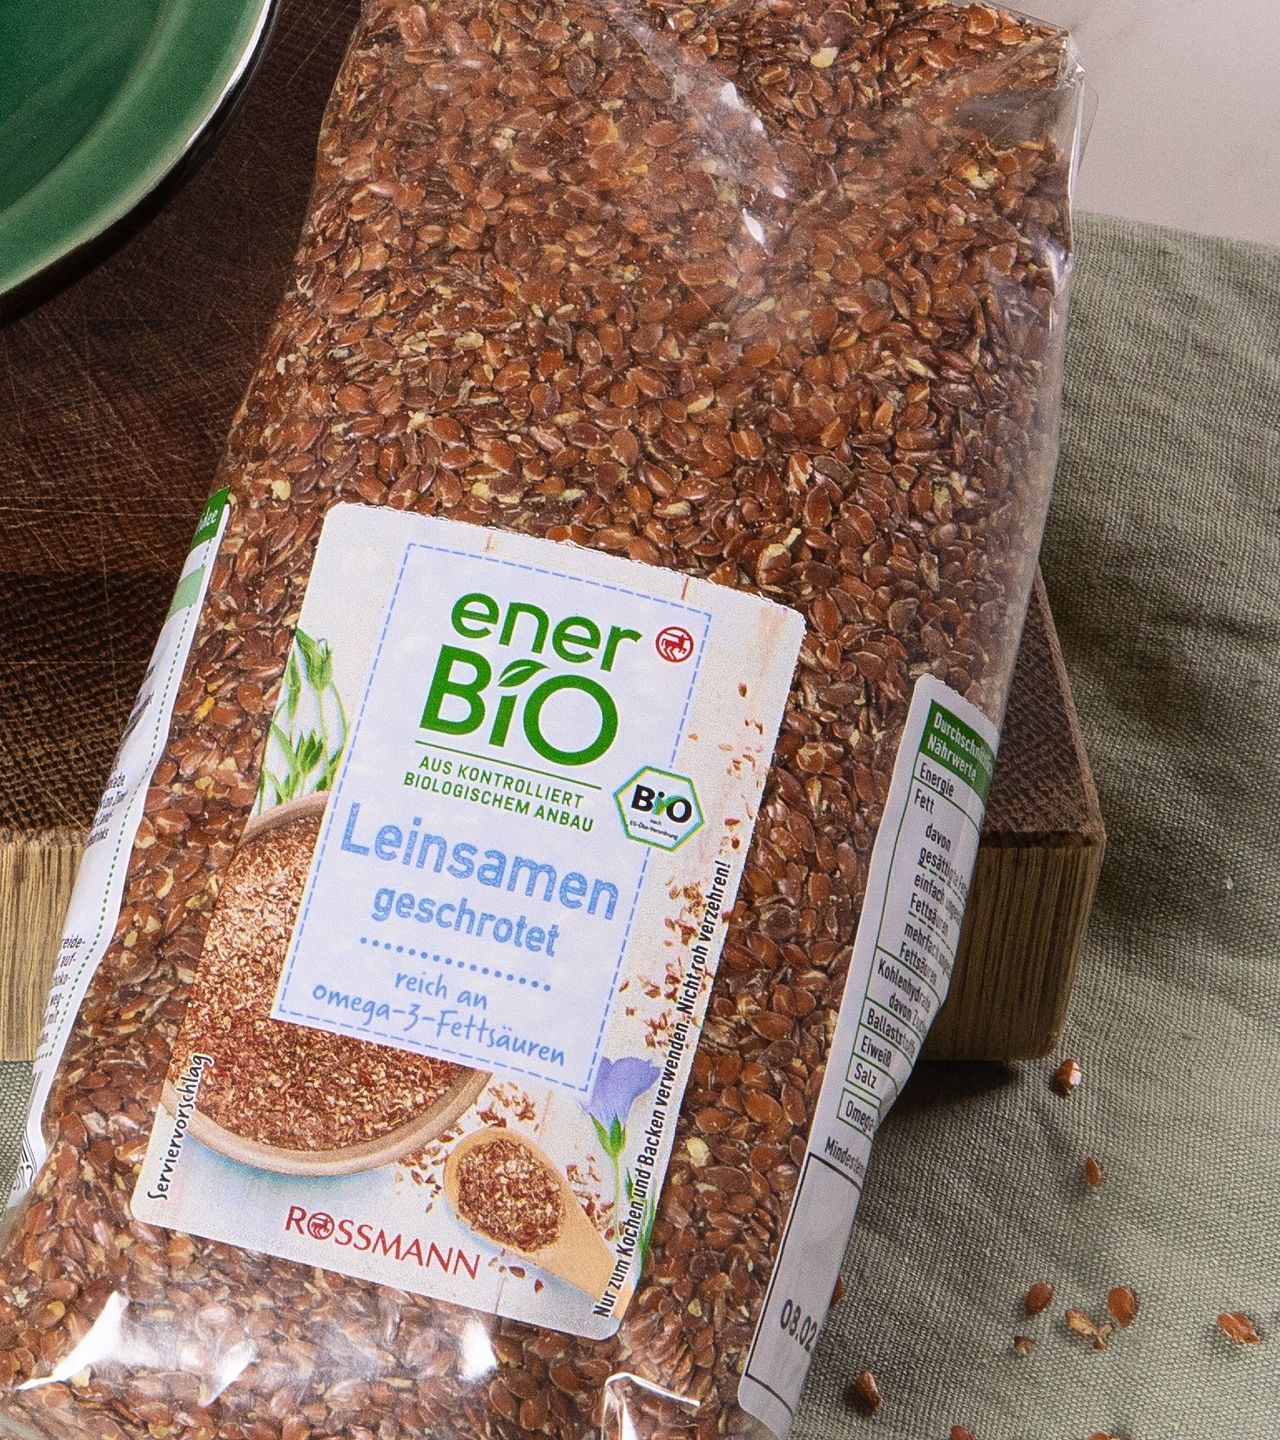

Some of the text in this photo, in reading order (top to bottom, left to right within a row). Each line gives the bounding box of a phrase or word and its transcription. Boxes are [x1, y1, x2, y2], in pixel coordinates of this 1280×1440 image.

[450, 592, 643, 672] ener
[418, 755, 585, 809] AUS KONTROLLIERT
[920, 762, 954, 799] Energie
[927, 733, 977, 781] Nährwerte
[403, 771, 595, 833] BIOLOGISCHEM ANBAU
[914, 788, 935, 815] Fett
[339, 802, 620, 921] Leinsamen
[925, 822, 952, 852] davon
[371, 886, 560, 958] geschrotet
[395, 971, 488, 1010] reich an
[889, 992, 913, 1021] davon
[312, 983, 566, 1067] omega-3-Fettsäuren
[854, 1062, 877, 1090] Salz
[860, 1035, 892, 1068] Eiweiß
[592, 860, 732, 1318] Nur zum Kochen und Backen verwenden. Nicht roh verzehren!
[146, 1052, 214, 1201] Serviervorschlag
